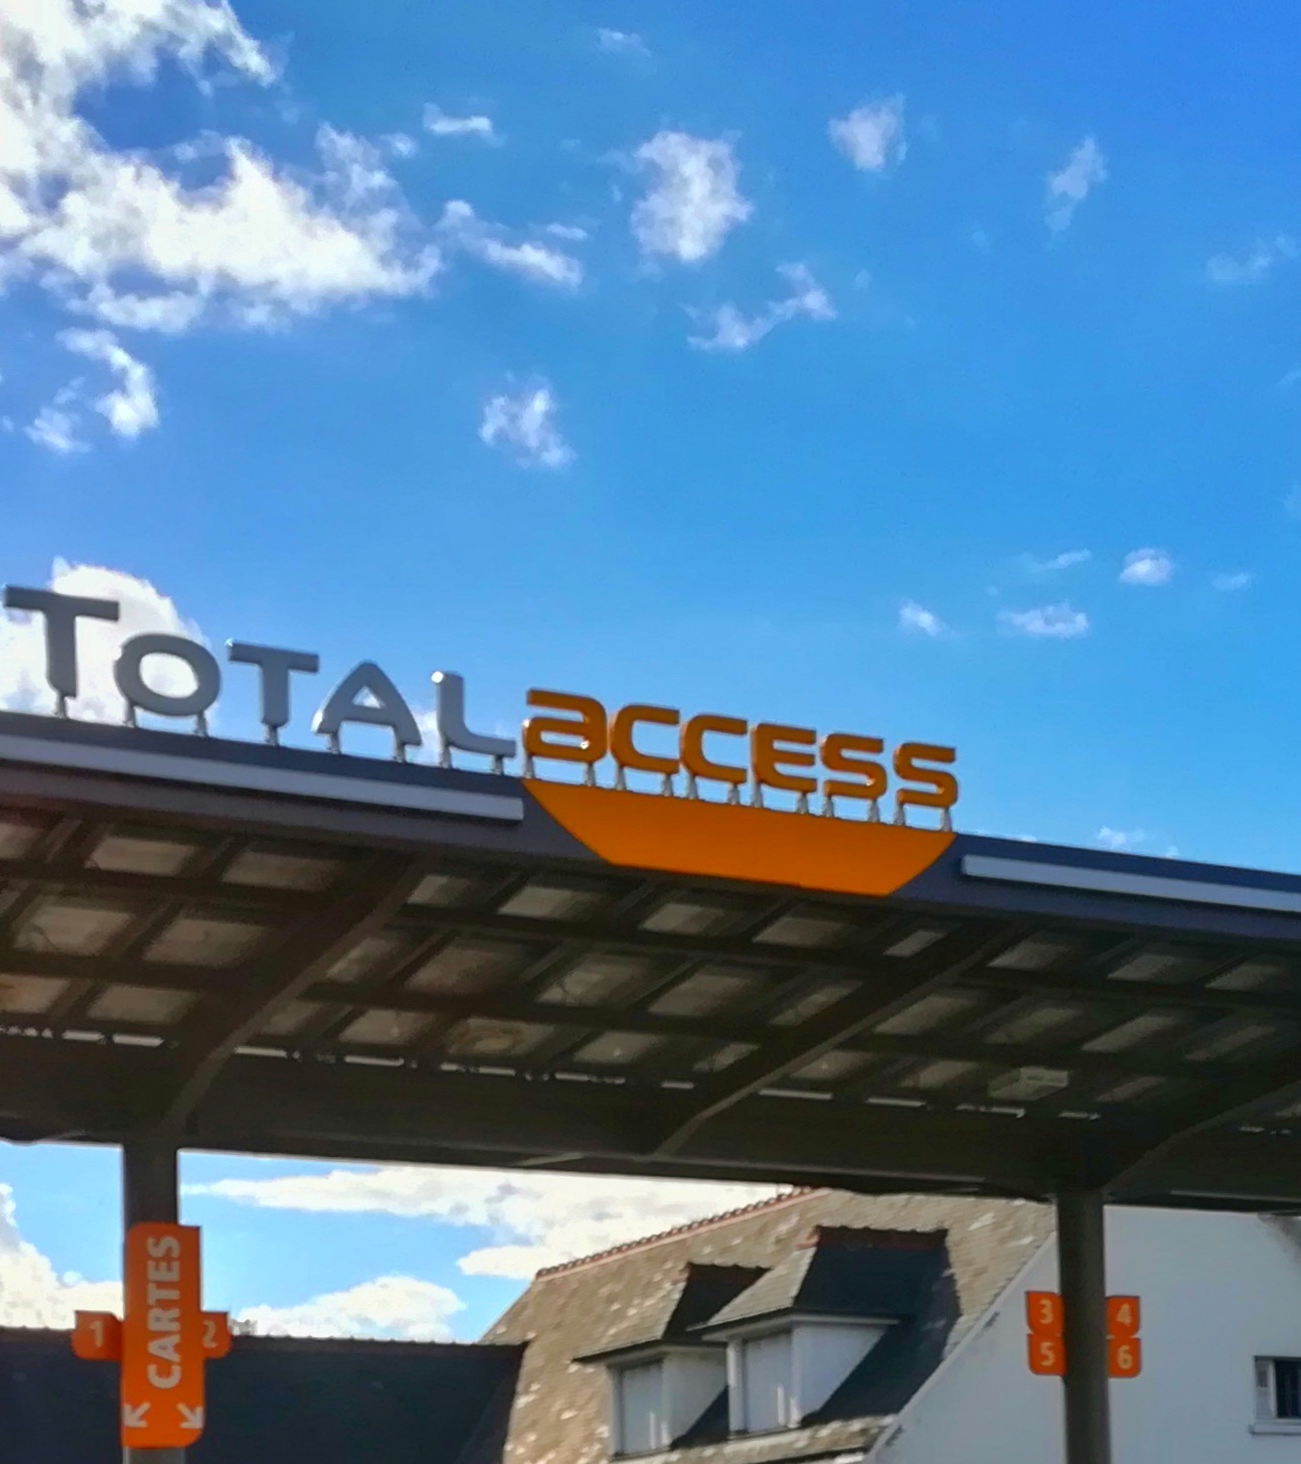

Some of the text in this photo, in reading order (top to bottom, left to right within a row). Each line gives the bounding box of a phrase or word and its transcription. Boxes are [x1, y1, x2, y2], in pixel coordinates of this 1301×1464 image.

[4, 584, 516, 764] TOTAL
[146, 1234, 182, 1389] CARTES
[1038, 1298, 1054, 1325] 3
[1116, 1302, 1132, 1327] 4
[1039, 1341, 1056, 1367] 5
[1116, 1344, 1134, 1370] 6
